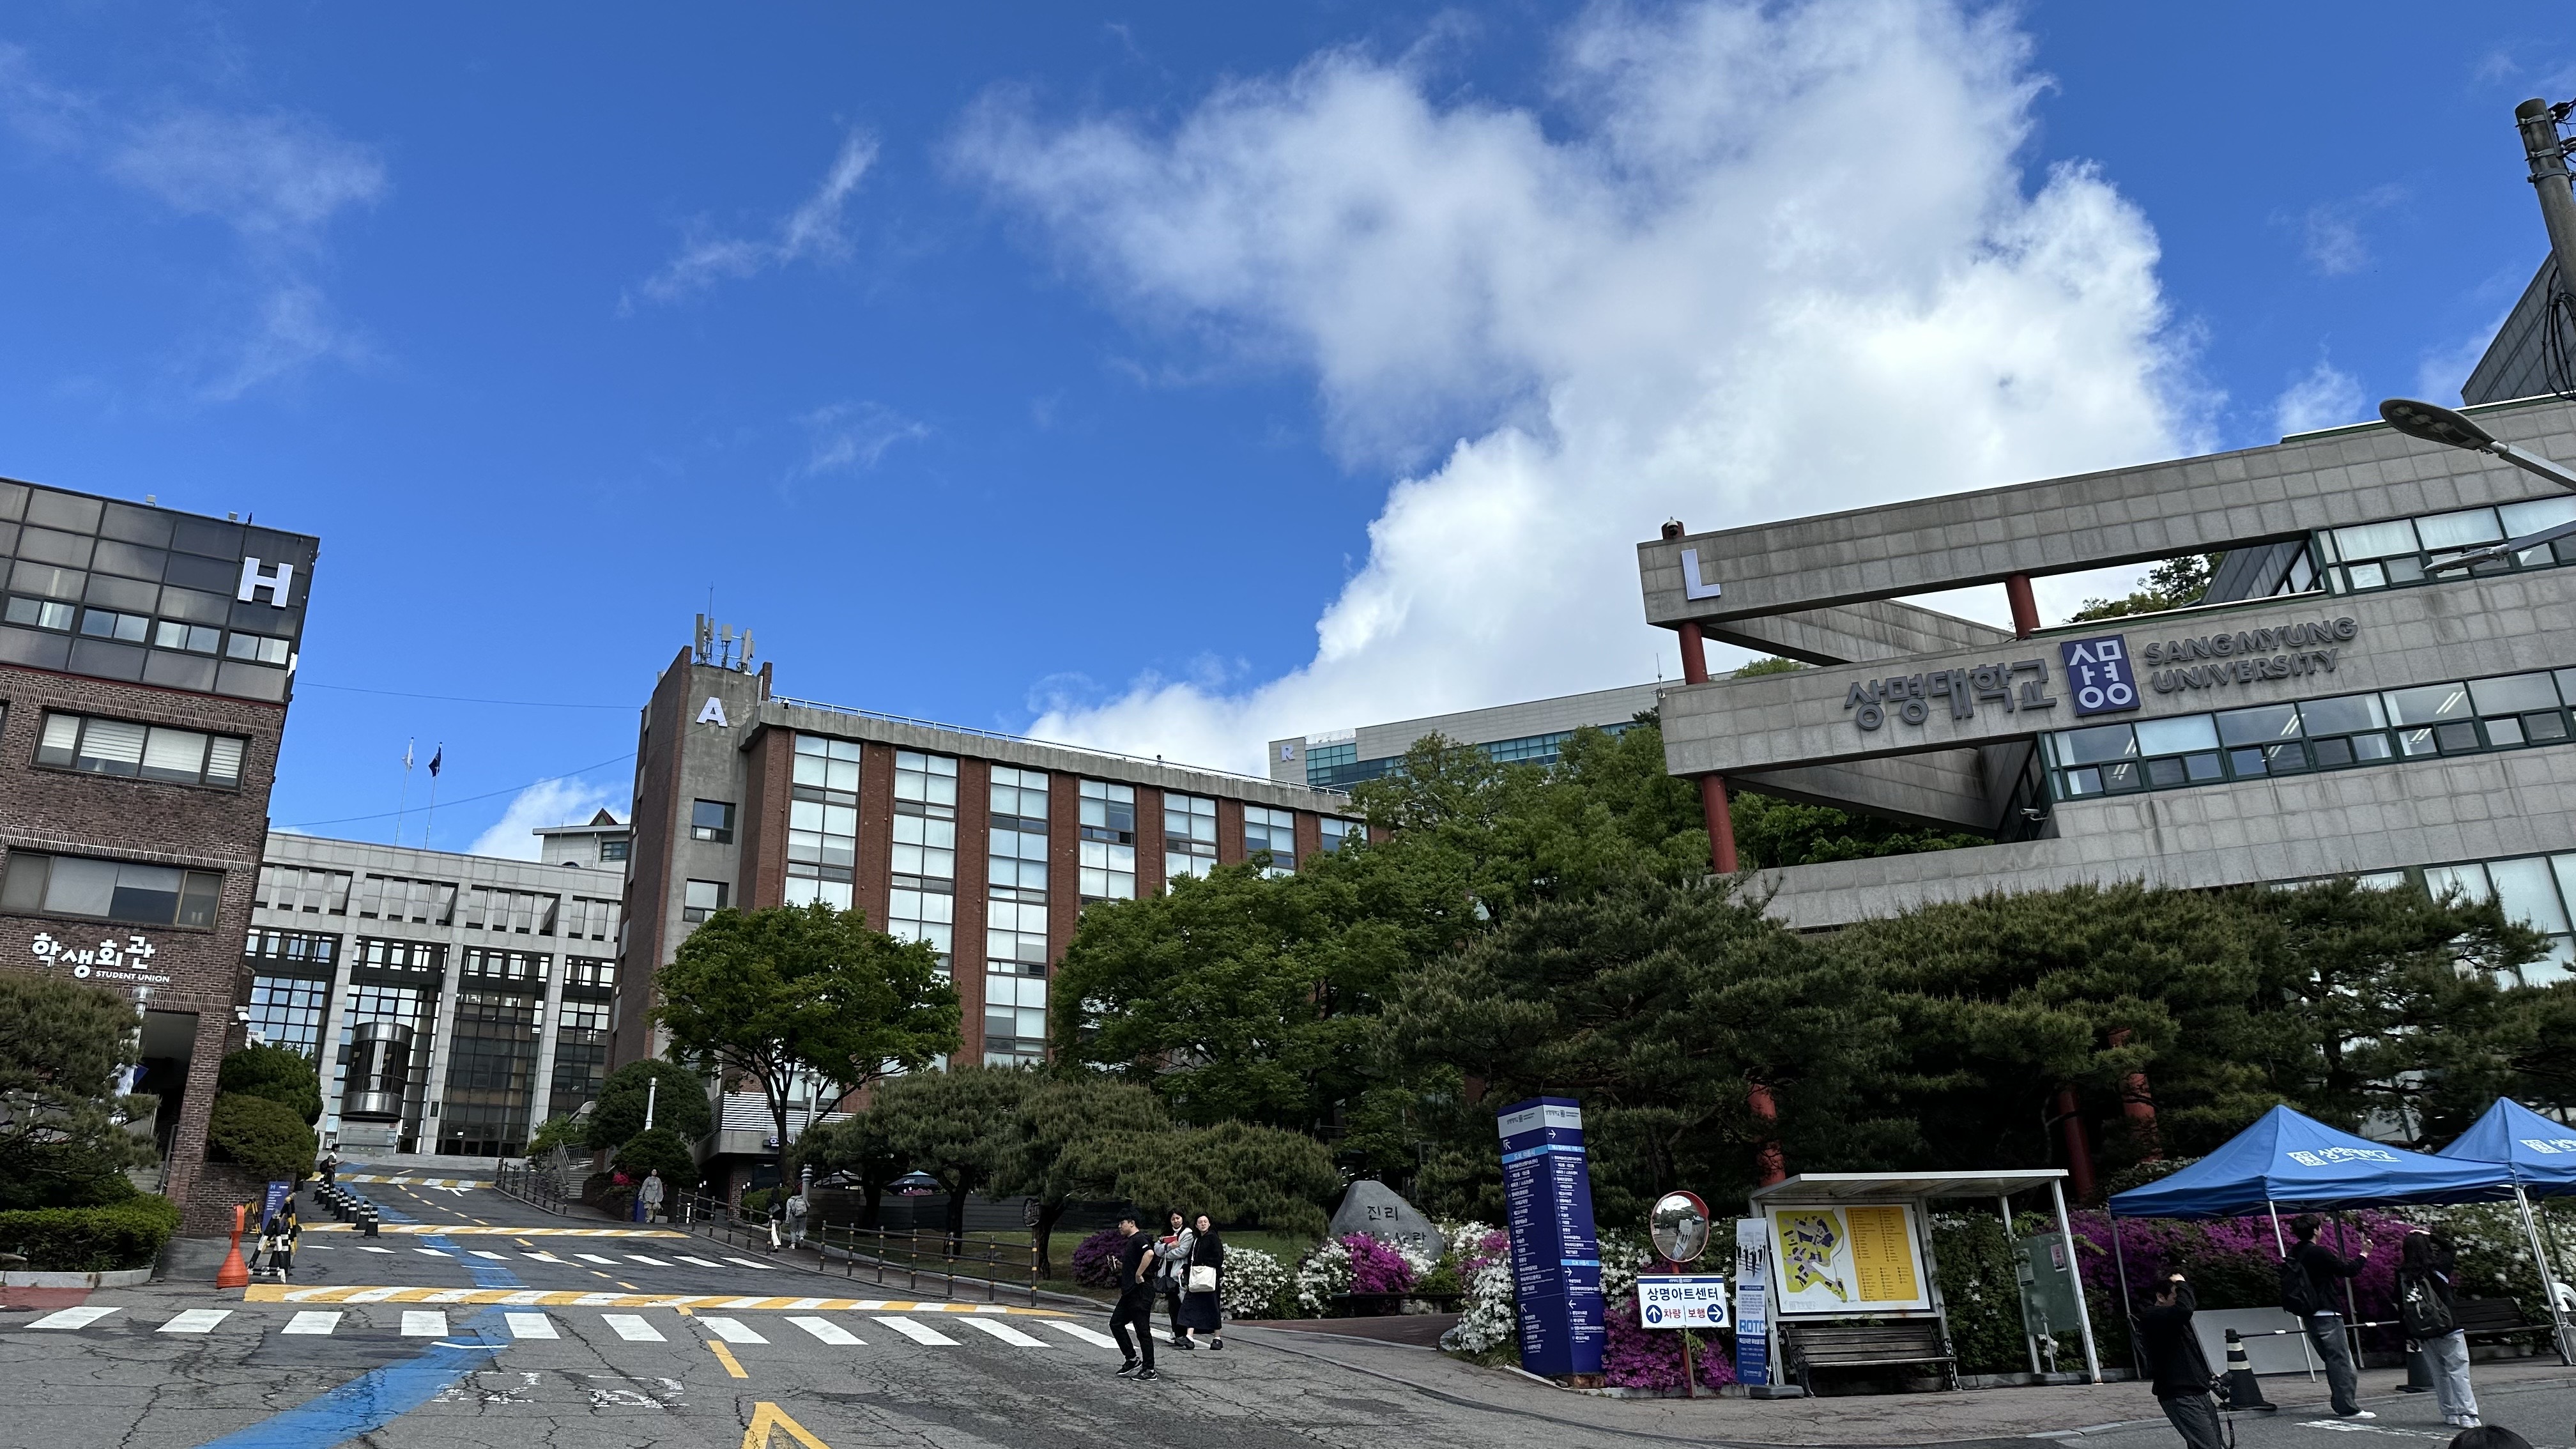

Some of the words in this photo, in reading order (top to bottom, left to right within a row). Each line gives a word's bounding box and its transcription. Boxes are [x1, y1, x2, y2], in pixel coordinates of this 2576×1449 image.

[237, 556, 294, 609] H
[1682, 549, 1721, 601] L
[2145, 617, 2359, 666] SANGMYUNG
[2152, 647, 2339, 693] UNIVERSITY
[1844, 658, 2057, 730] 상명대학교
[696, 696, 728, 728] A
[1280, 744, 1296, 762] R
[32, 932, 156, 979] 학생회관
[96, 970, 136, 981] STUDENT
[138, 973, 170, 983] UNION
[1367, 1206, 1399, 1222] 진리
[1647, 1287, 1719, 1301] 상명아트센터
[1664, 1308, 1681, 1319] 차량
[1688, 1308, 1706, 1319] 보행
[1739, 1319, 1765, 1333] ROTC
